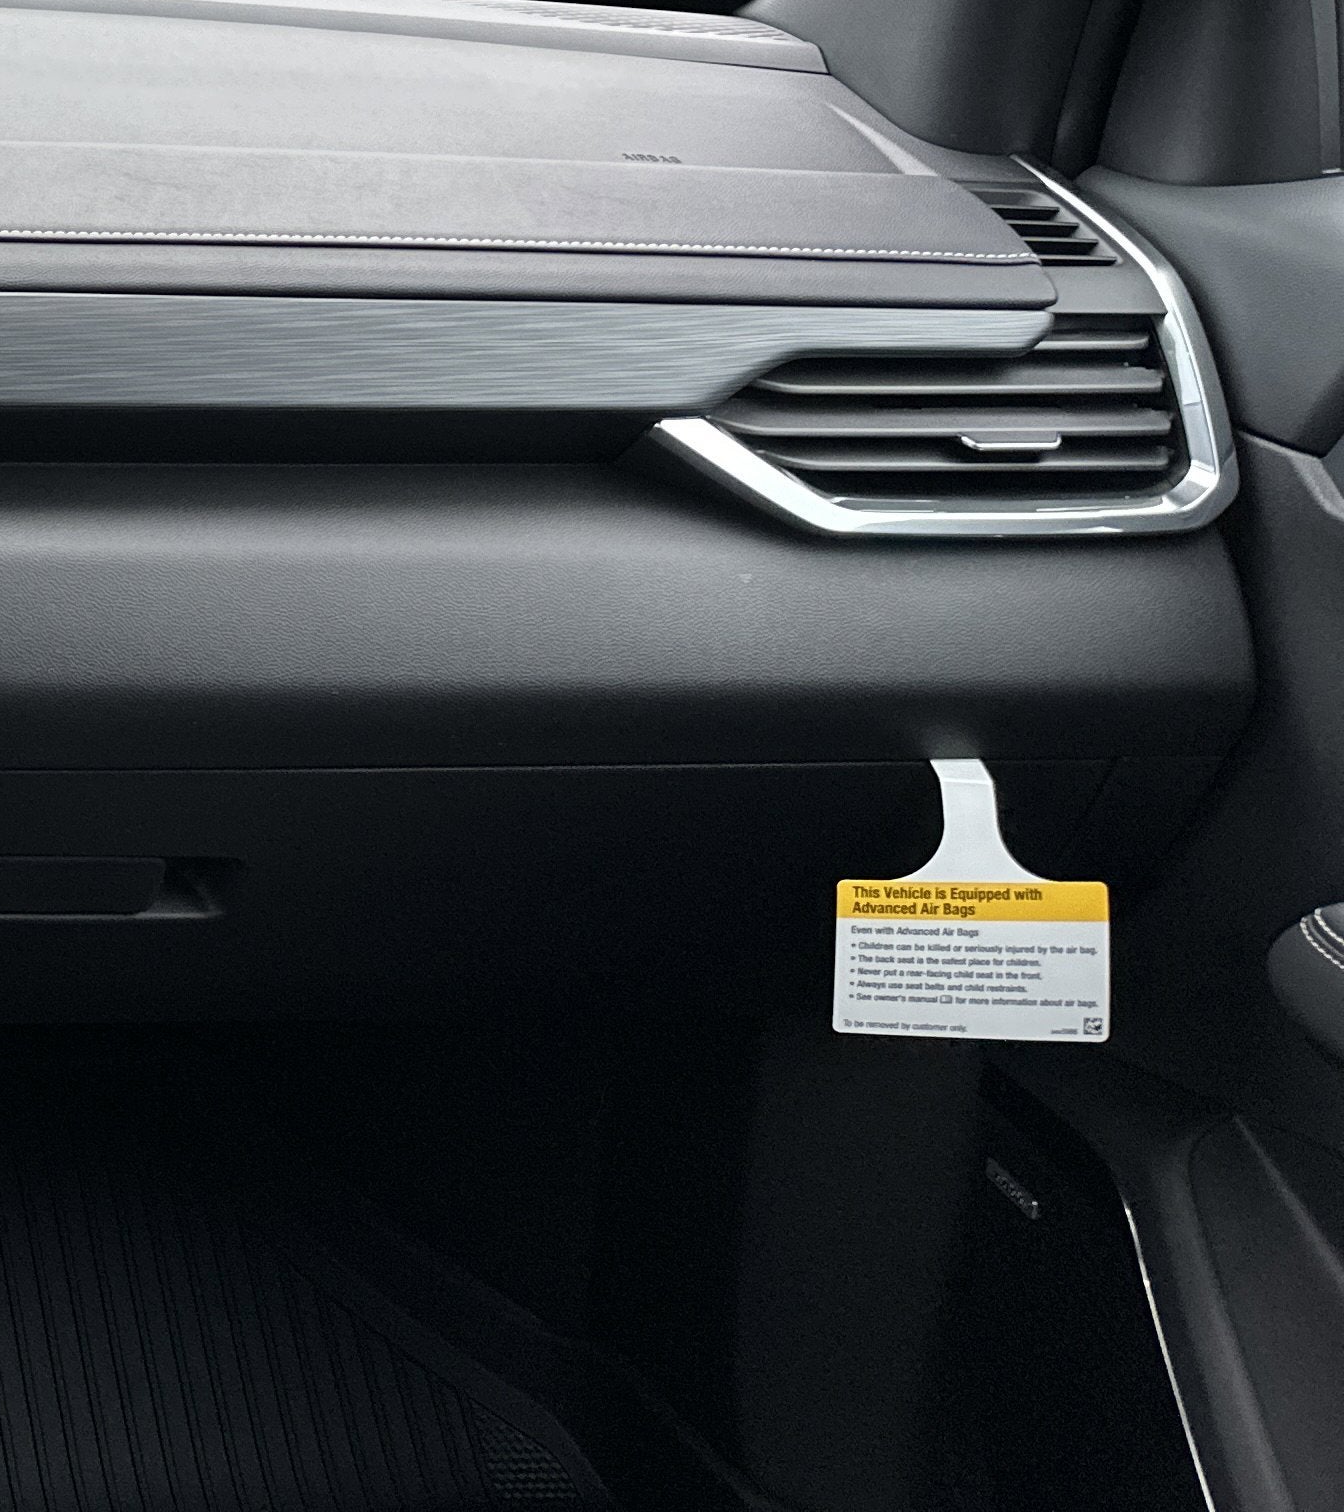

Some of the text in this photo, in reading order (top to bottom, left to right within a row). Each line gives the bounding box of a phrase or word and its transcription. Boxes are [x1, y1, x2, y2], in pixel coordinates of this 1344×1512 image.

[853, 886, 1042, 902] This Vehicle is Equipped with
[852, 902, 976, 918] Advanced Air Bags
[851, 926, 872, 934] Even
[896, 927, 940, 936] Advanced
[942, 928, 954, 936] Air
[957, 928, 979, 938] Bags
[858, 942, 894, 950] Children
[914, 943, 924, 951] be
[1038, 946, 1048, 954] by
[1050, 946, 1063, 954] the
